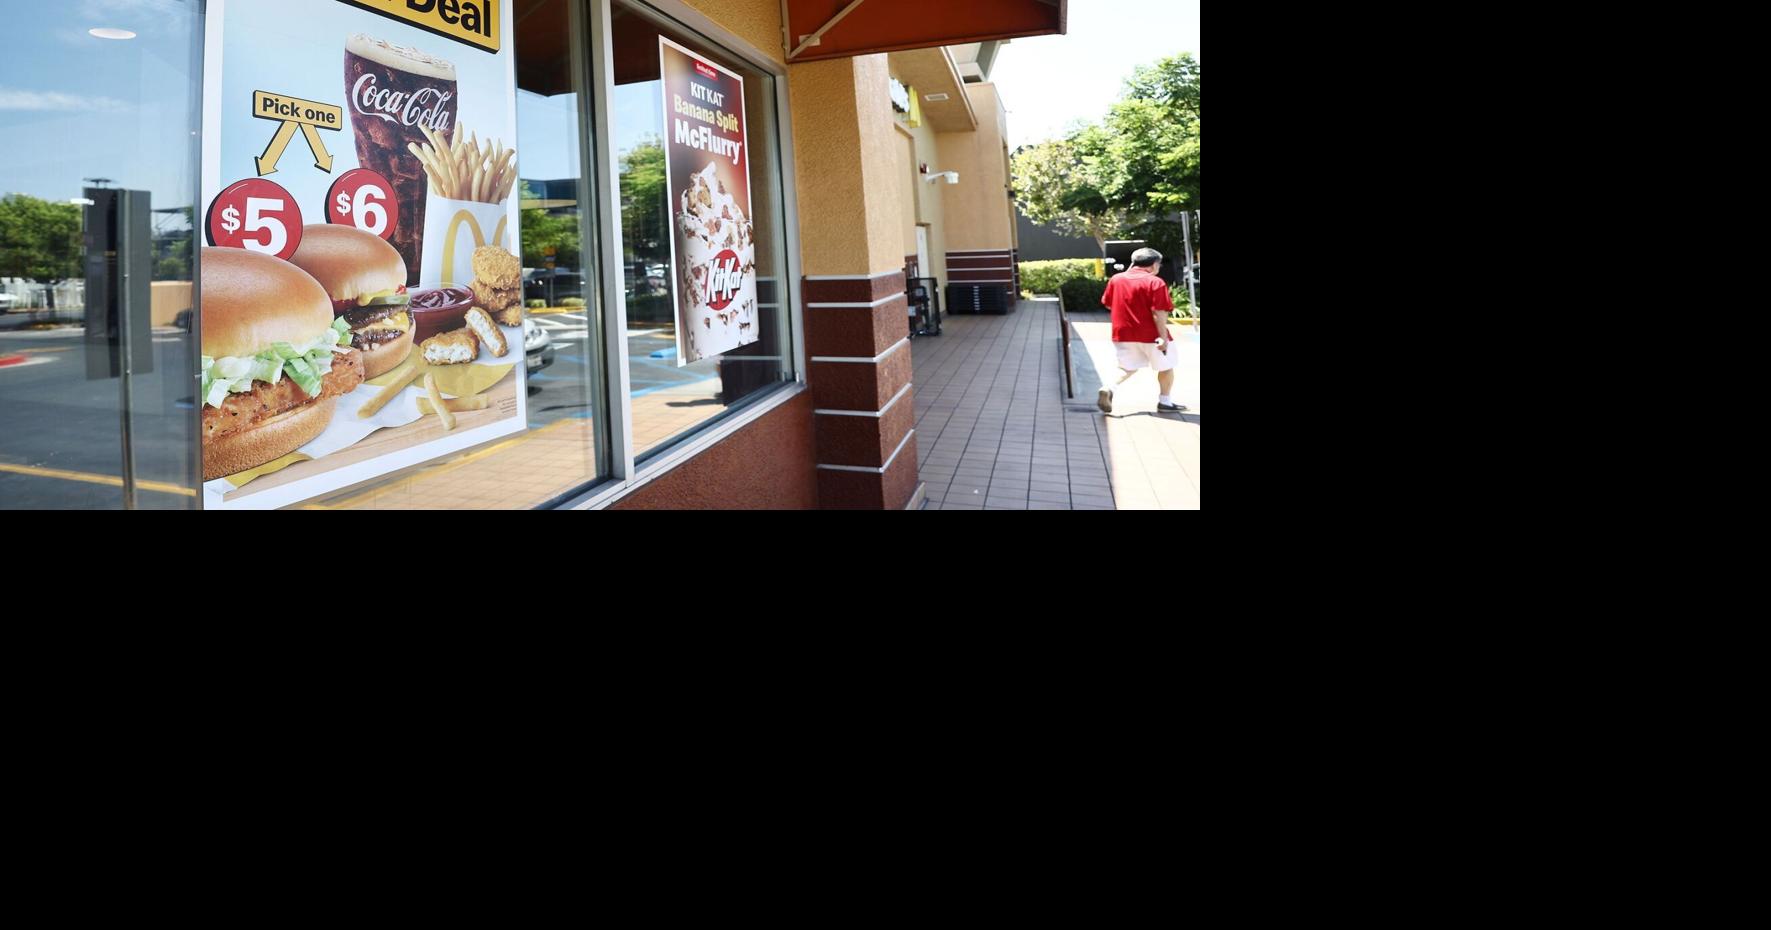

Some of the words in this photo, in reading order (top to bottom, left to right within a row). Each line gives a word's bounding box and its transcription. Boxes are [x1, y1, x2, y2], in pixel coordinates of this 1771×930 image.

[262, 97, 301, 118] Pick
[304, 108, 336, 123] one
[673, 94, 715, 124] Banana
[716, 110, 739, 133] Split
[221, 196, 288, 254] $5
[336, 184, 387, 237] $6
